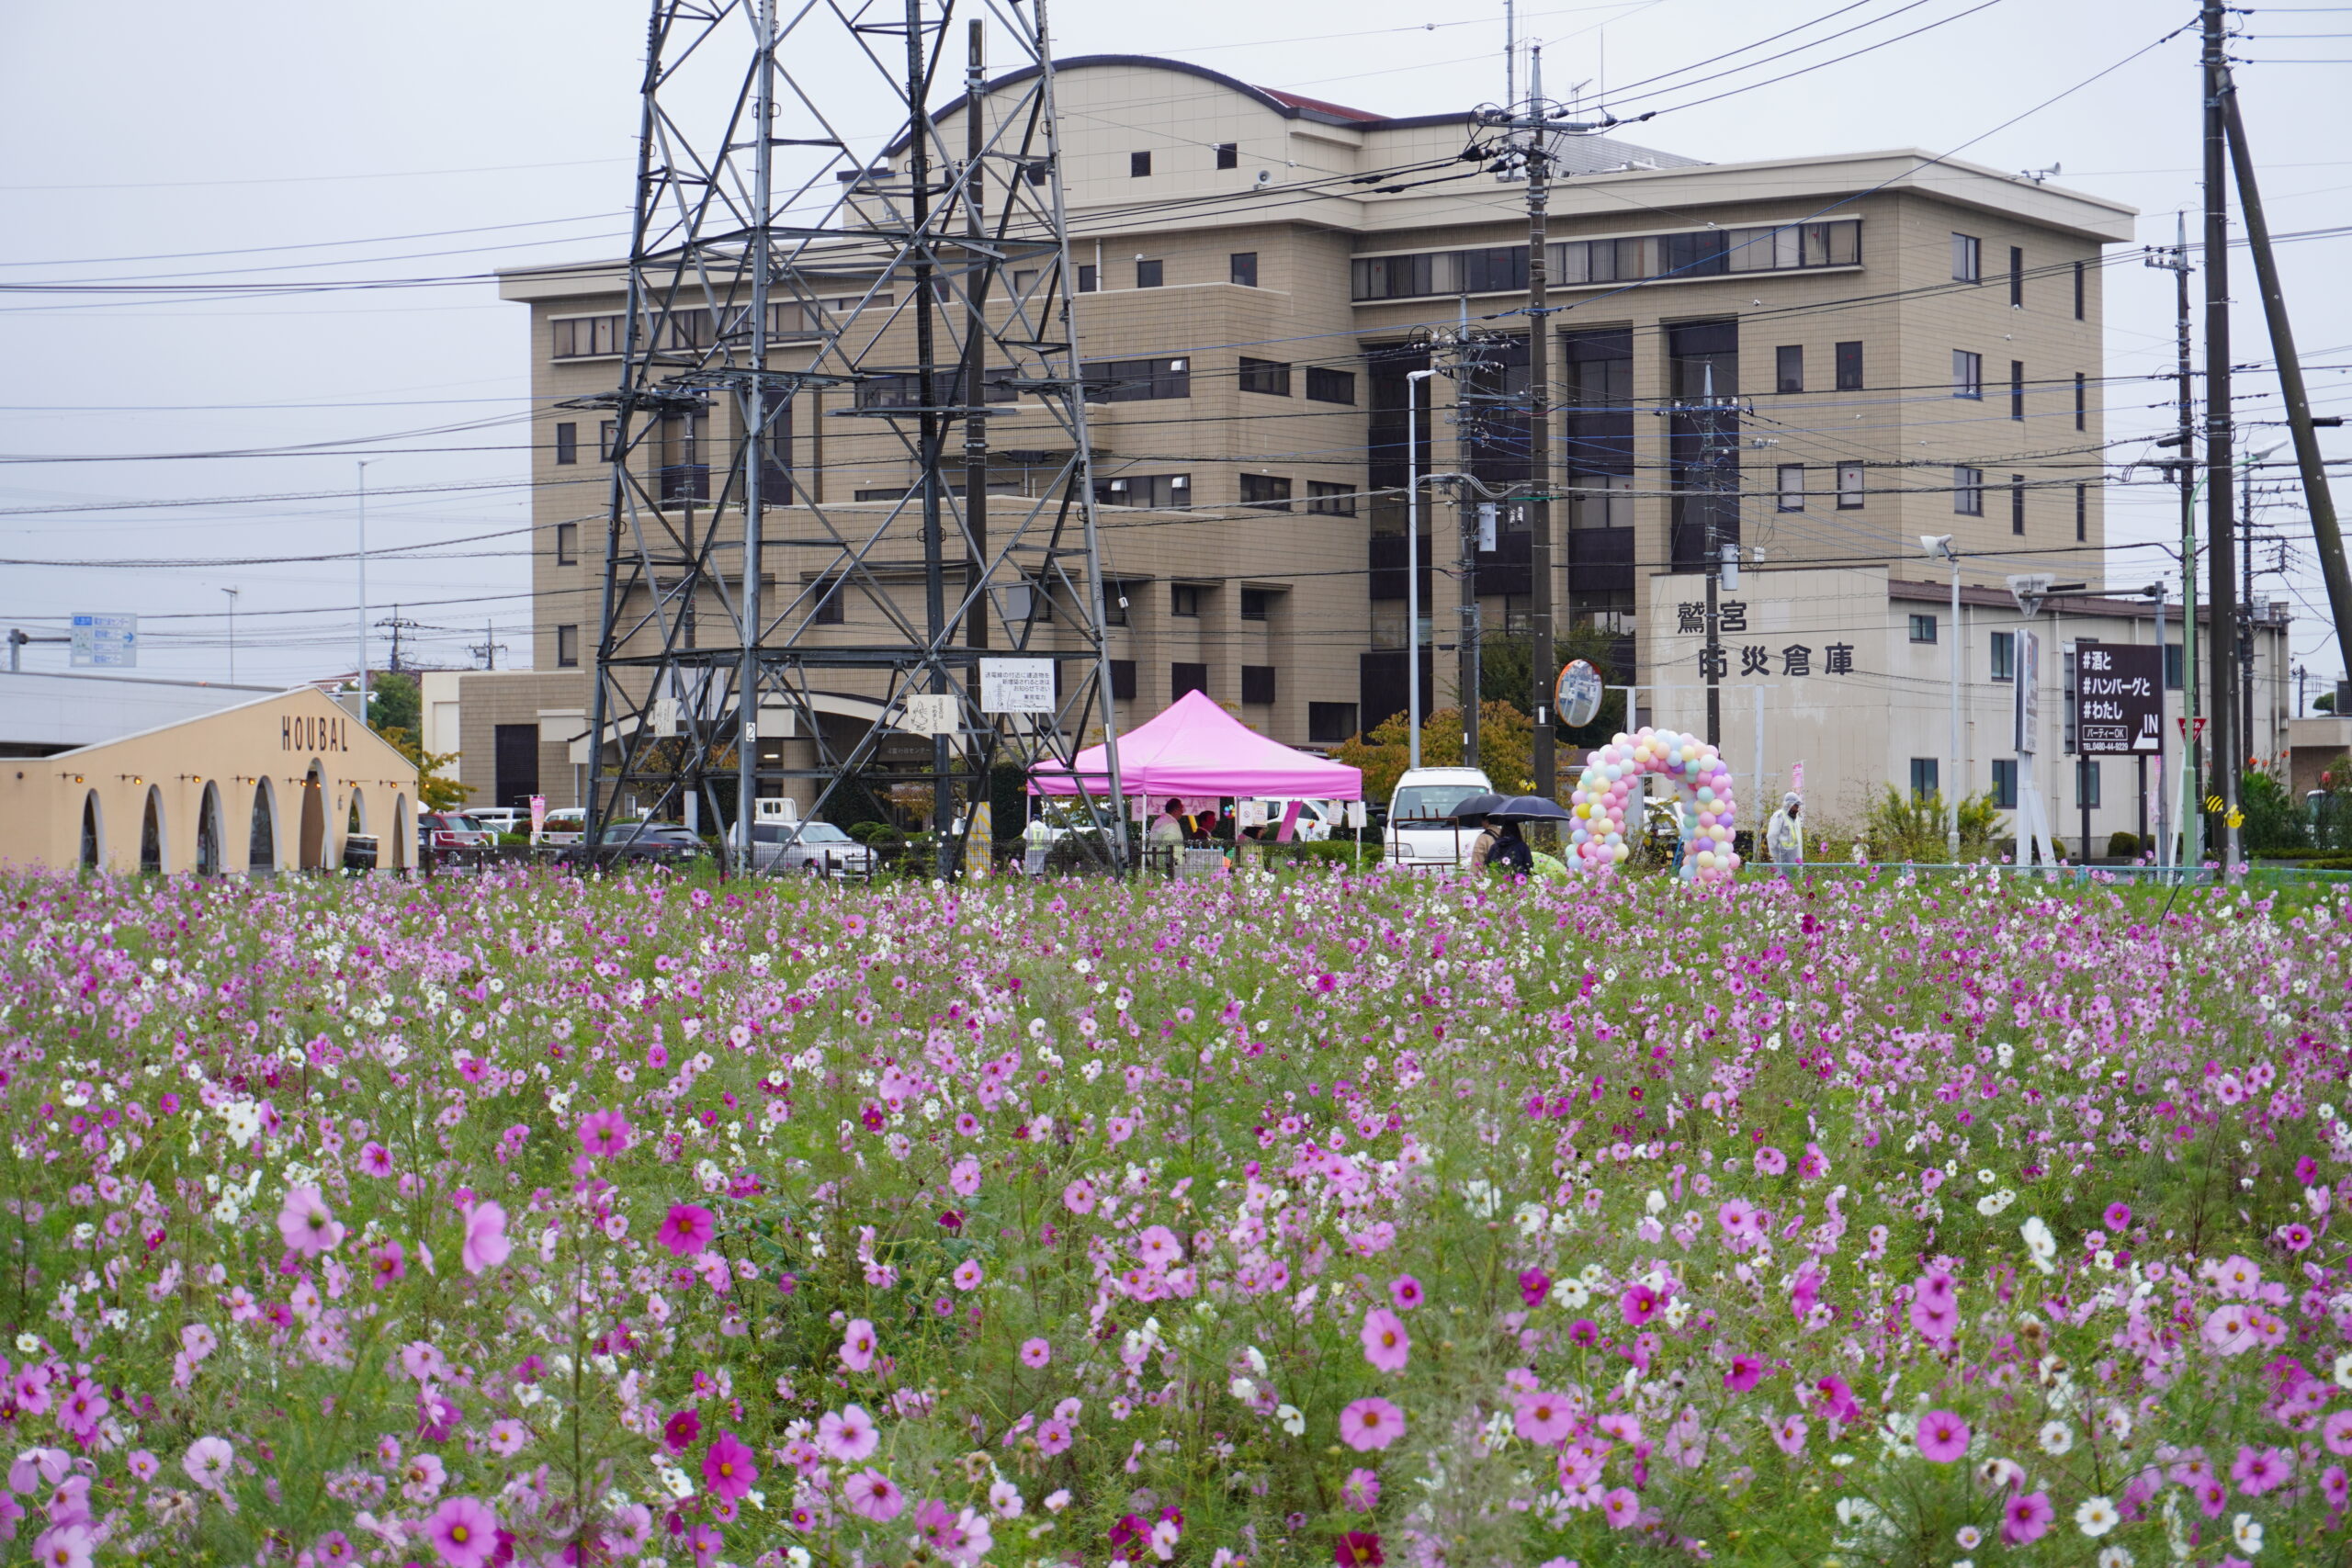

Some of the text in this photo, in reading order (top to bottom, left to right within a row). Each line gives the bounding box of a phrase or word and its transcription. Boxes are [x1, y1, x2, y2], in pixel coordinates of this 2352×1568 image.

[1678, 600, 1747, 634] 鷲宮
[1699, 642, 1854, 678] 防災倉庫
[2083, 651, 2111, 671] #酒と
[2083, 677, 2151, 696] #ハンバーグと
[2083, 701, 2122, 720] #わたし
[282, 715, 347, 752] HOUBAL
[2087, 728, 2124, 739] パーティーOK
[2143, 714, 2158, 734] IN
